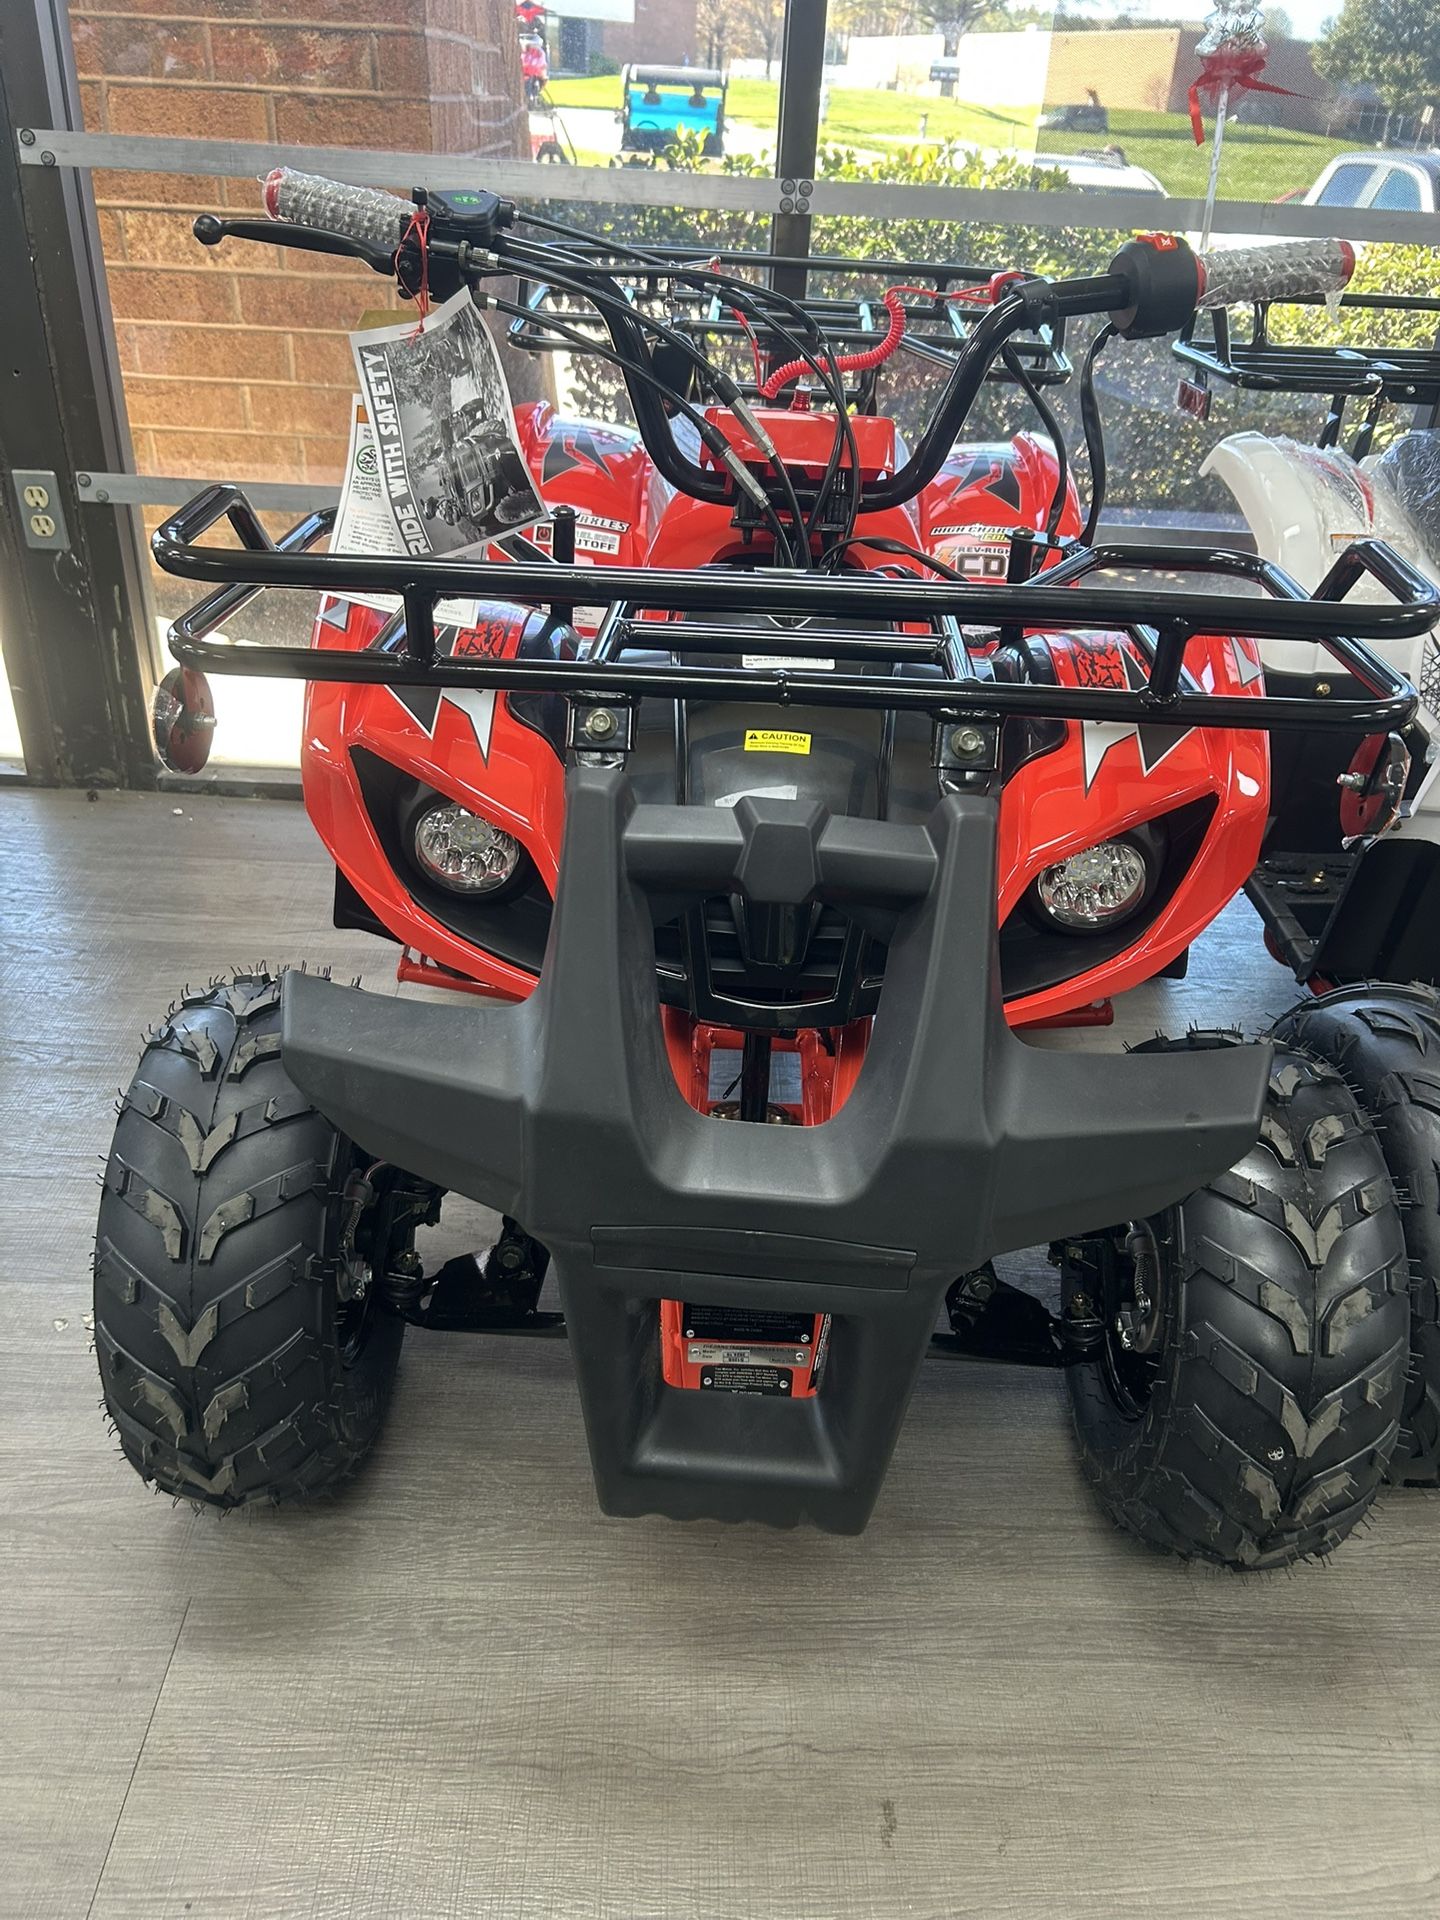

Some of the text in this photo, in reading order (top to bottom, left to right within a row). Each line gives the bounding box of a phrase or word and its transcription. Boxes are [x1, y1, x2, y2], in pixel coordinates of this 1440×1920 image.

[362, 351, 431, 556] RIDE WITH SAFETY
[968, 526, 1006, 534] CHAR
[761, 733, 807, 742] CAUTION
